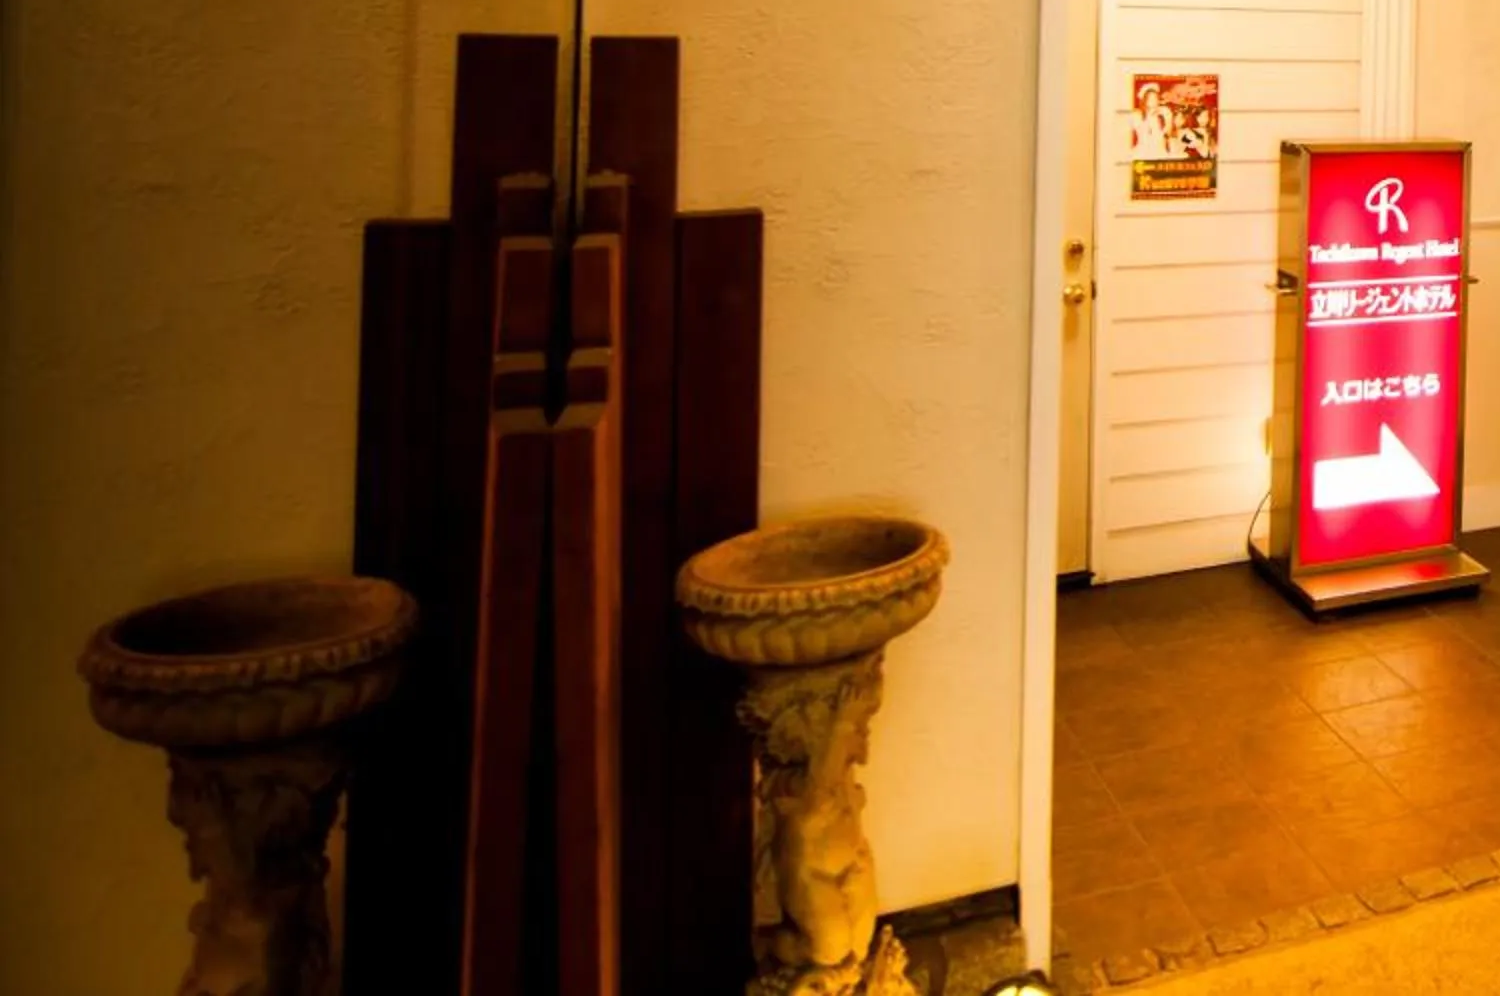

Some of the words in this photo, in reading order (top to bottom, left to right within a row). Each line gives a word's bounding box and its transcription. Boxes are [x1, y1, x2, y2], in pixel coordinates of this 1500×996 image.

[1320, 372, 1441, 406] 入口はこちら
